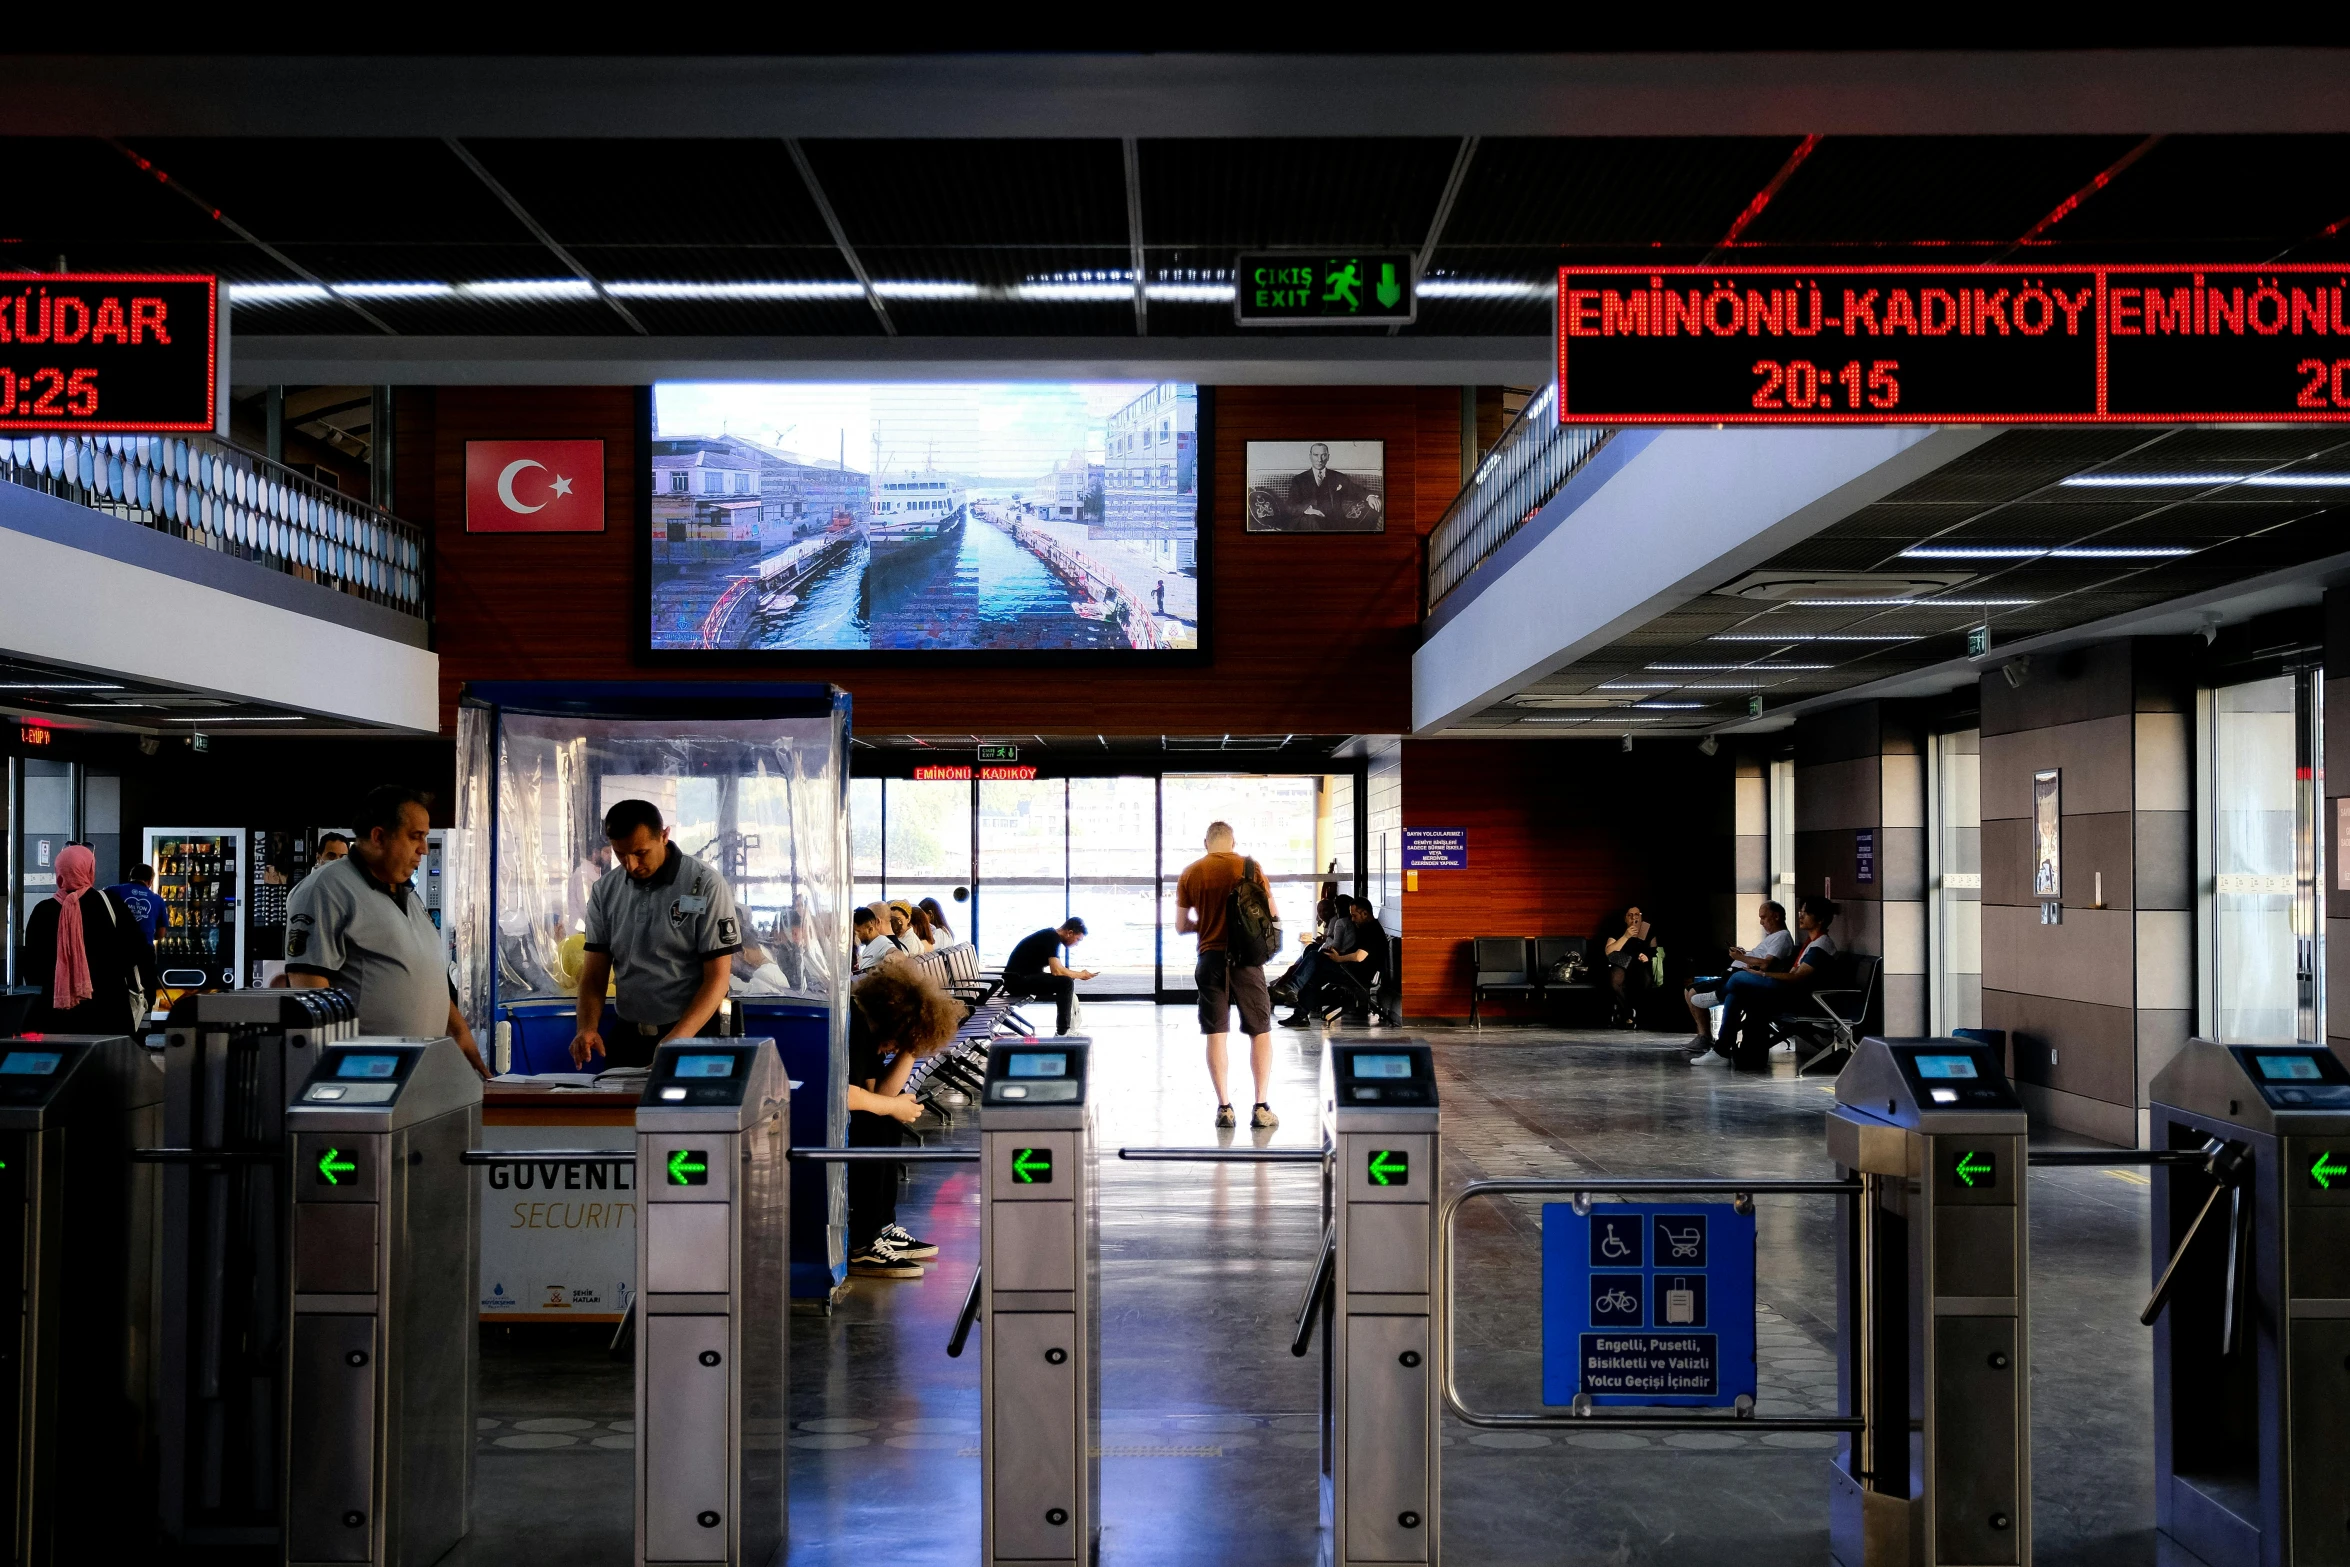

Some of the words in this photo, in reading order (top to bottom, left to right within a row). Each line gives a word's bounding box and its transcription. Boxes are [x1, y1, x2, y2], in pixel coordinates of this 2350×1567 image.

[1255, 290, 1311, 307] EXIT
[1568, 276, 2093, 336] EMİNÖNÜ-KADIKÖY
[1752, 360, 1900, 409] 20:15
[916, 766, 972, 780] EMİNÖNÜ
[982, 766, 1036, 780] KADIKÖY
[254, 838, 265, 881] BREAK
[1596, 1339, 1647, 1353] Engelli,
[1650, 1339, 1701, 1353] Pusetli,
[1588, 1356, 1647, 1369] Bisikletli
[1650, 1359, 1666, 1369] ve
[1668, 1356, 1710, 1369] Valizli
[1587, 1374, 1622, 1387] Yolcu
[1625, 1374, 1665, 1390] Geçişi
[1667, 1373, 1710, 1389] İçindir
